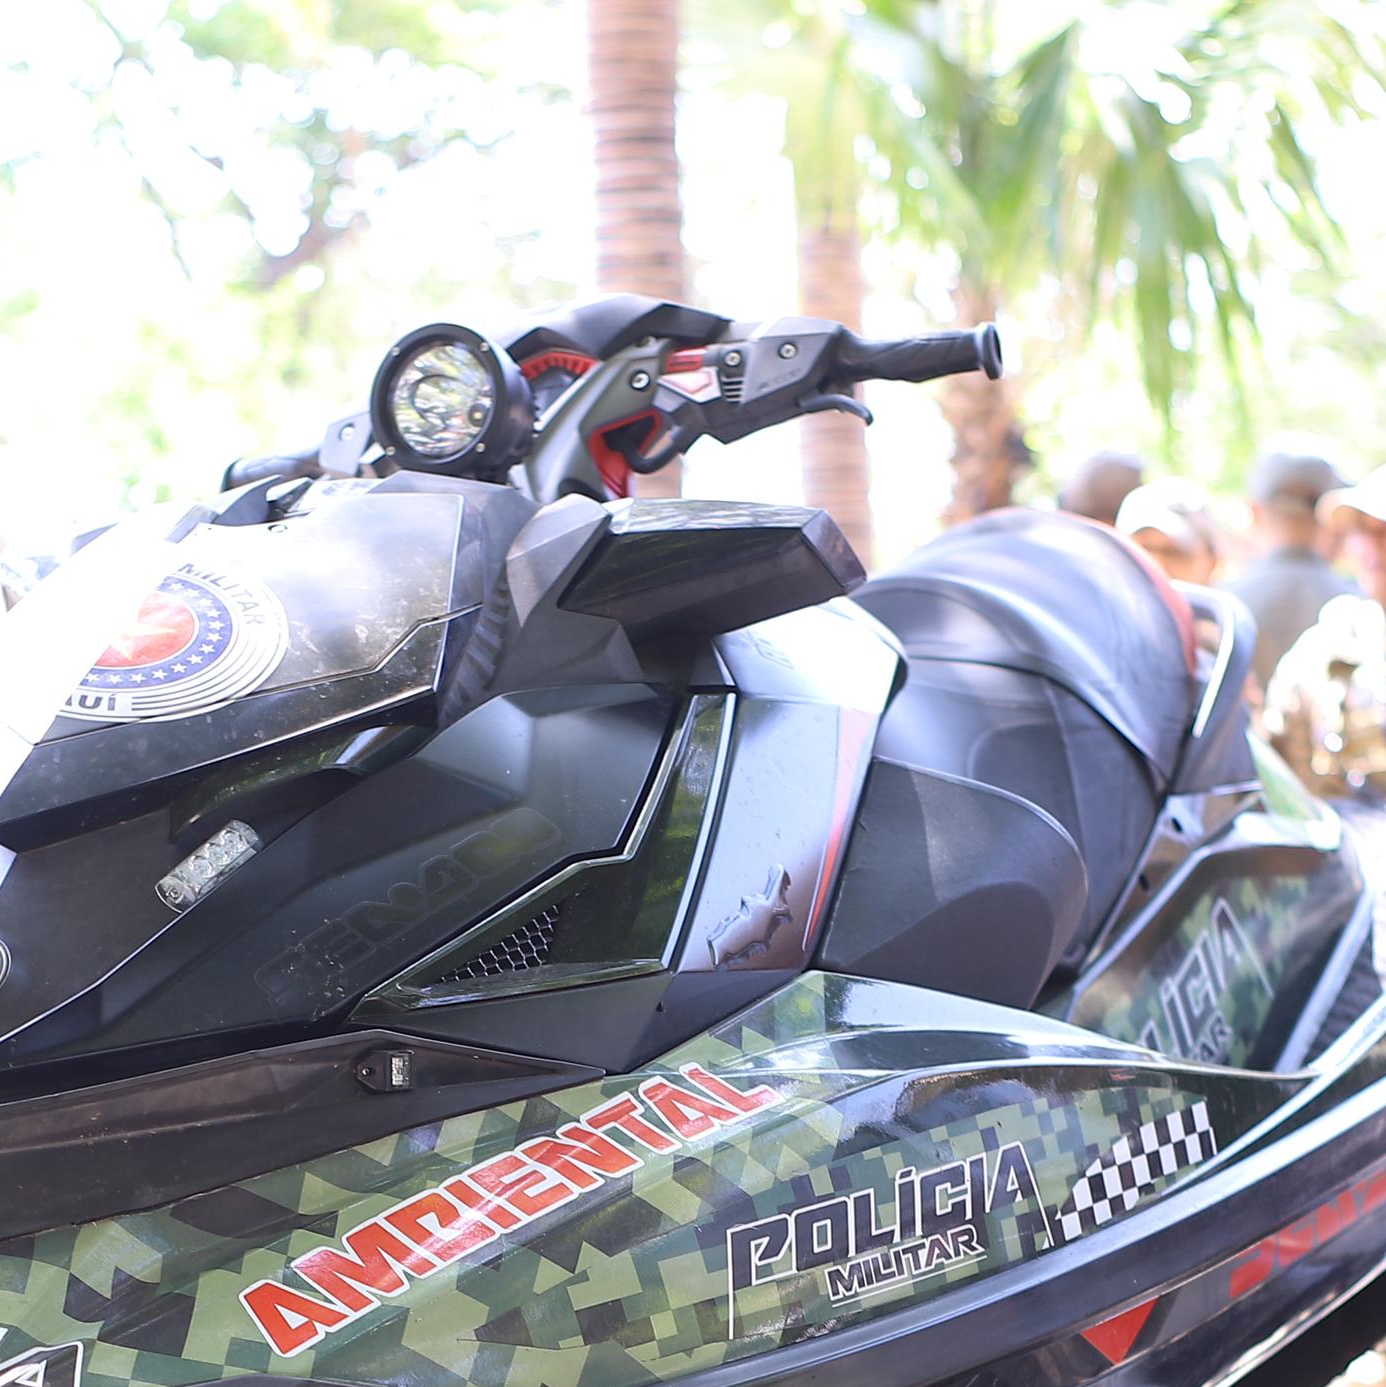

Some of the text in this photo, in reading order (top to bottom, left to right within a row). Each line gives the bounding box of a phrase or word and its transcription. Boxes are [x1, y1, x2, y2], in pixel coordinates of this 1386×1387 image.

[238, 1061, 784, 1358] AMBIENTAL
[726, 1140, 1055, 1340] POLÍCIA
[824, 1223, 986, 1303] MILITAR
